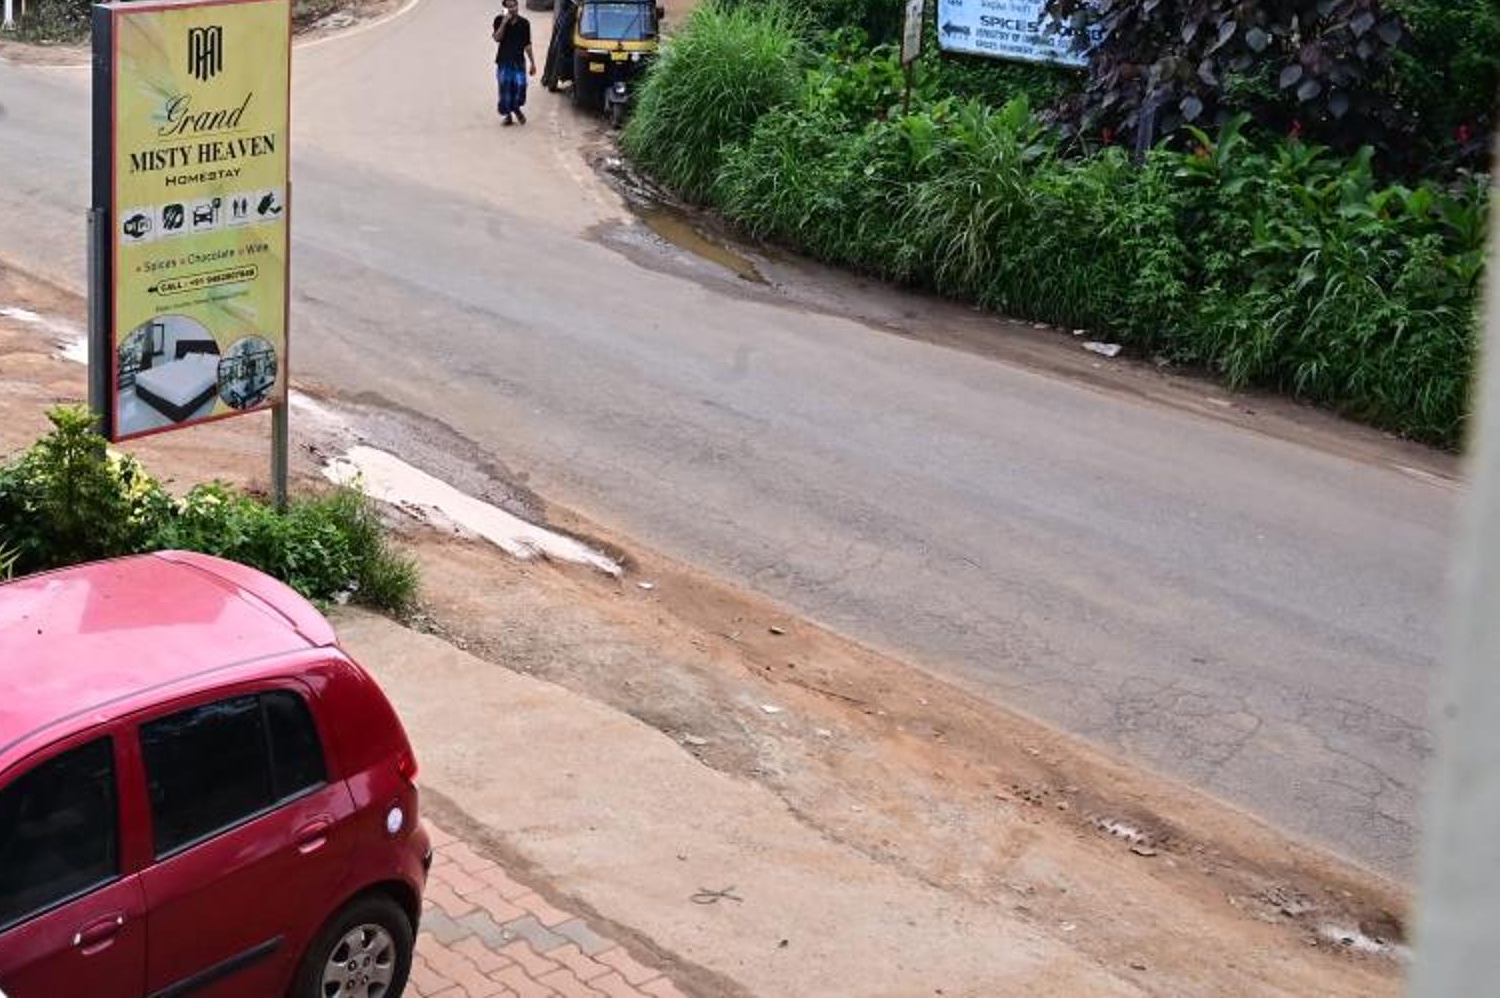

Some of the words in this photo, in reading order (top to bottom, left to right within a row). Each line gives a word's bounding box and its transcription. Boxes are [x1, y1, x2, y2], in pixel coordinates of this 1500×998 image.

[980, 15, 1040, 33] SPICES
[158, 91, 253, 136] Grand
[130, 145, 192, 173] MISTY
[197, 134, 276, 165] HEAVEN
[165, 168, 241, 186] HOMESTAY
[144, 256, 177, 273] Spices
[187, 248, 235, 265] Chocolate
